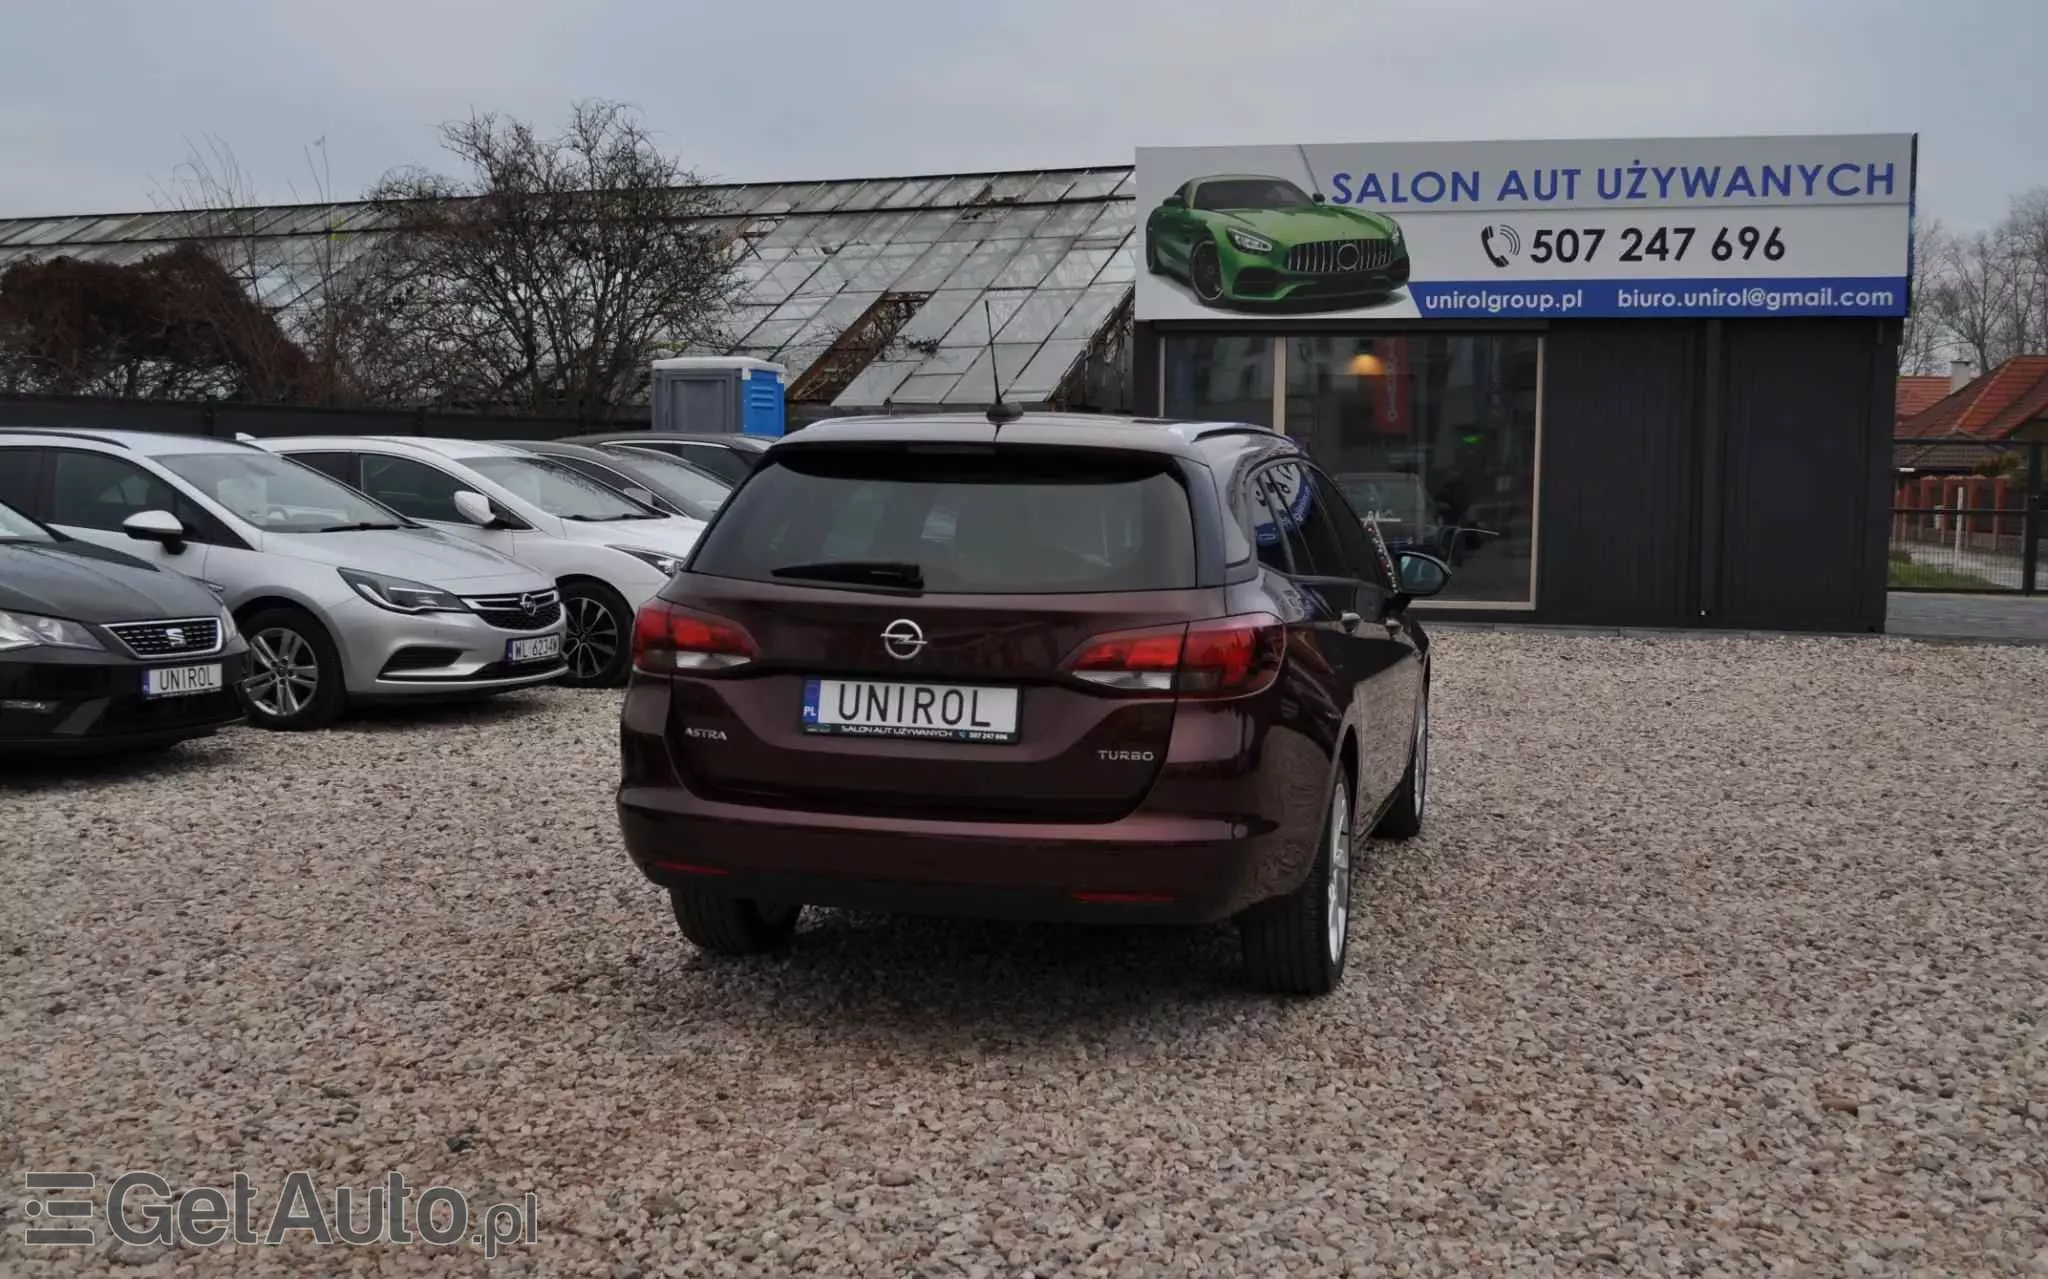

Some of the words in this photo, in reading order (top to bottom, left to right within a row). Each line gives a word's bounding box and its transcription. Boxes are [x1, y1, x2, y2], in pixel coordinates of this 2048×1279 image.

[1331, 171, 1480, 204] SALON
[1496, 169, 1582, 202] AUT
[1596, 159, 1895, 200] UŻYWANYCH
[1530, 228, 1606, 264] 507
[1618, 226, 1697, 262] 247
[1710, 225, 1786, 261] 696
[1425, 289, 1583, 312] unirolgroup.pl
[1617, 288, 1894, 311] biuro.unirol@gmail.com
[160, 665, 215, 691] UNIROL
[804, 705, 817, 717] PL
[838, 683, 991, 728] UNIROL
[685, 727, 728, 741] ASTRA
[1098, 749, 1154, 762] TURBO
